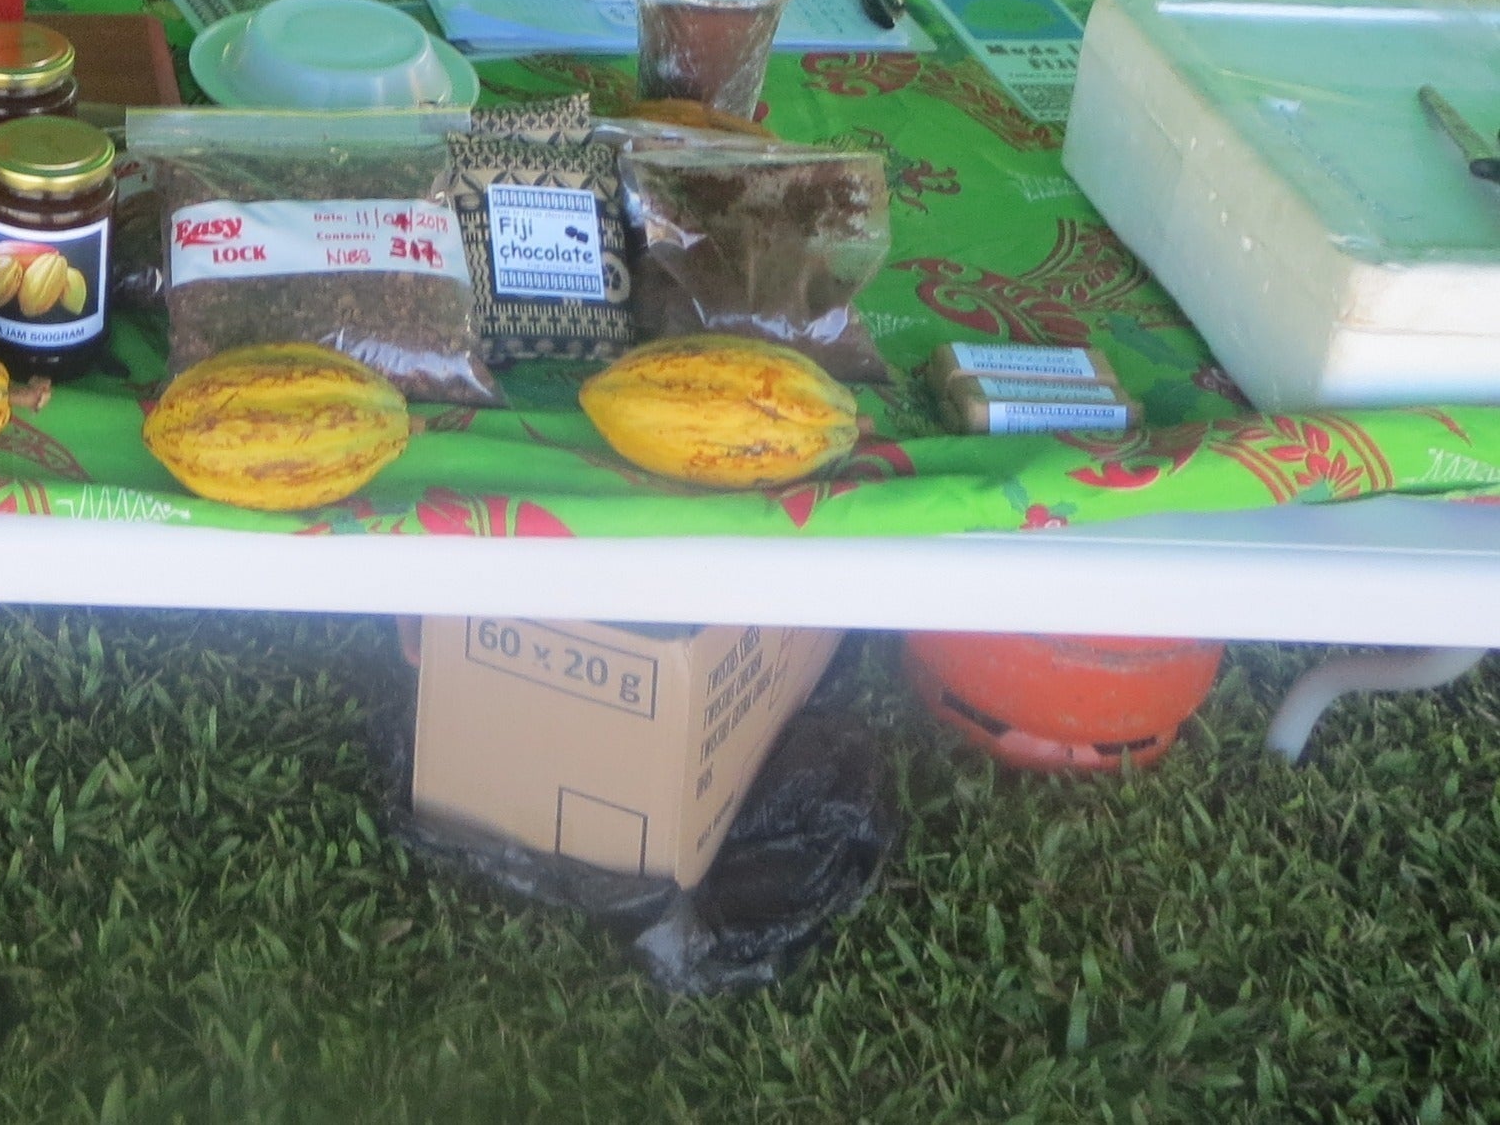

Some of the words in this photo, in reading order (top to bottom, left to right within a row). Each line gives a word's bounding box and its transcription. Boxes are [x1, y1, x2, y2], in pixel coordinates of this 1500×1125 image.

[174, 216, 243, 249] Easy
[498, 216, 534, 242] Fiji
[212, 244, 267, 265] LOCK
[499, 241, 594, 267] chocolate
[477, 618, 522, 659] 60
[533, 642, 552, 672] x
[563, 647, 610, 687] 20
[618, 671, 642, 704] g
